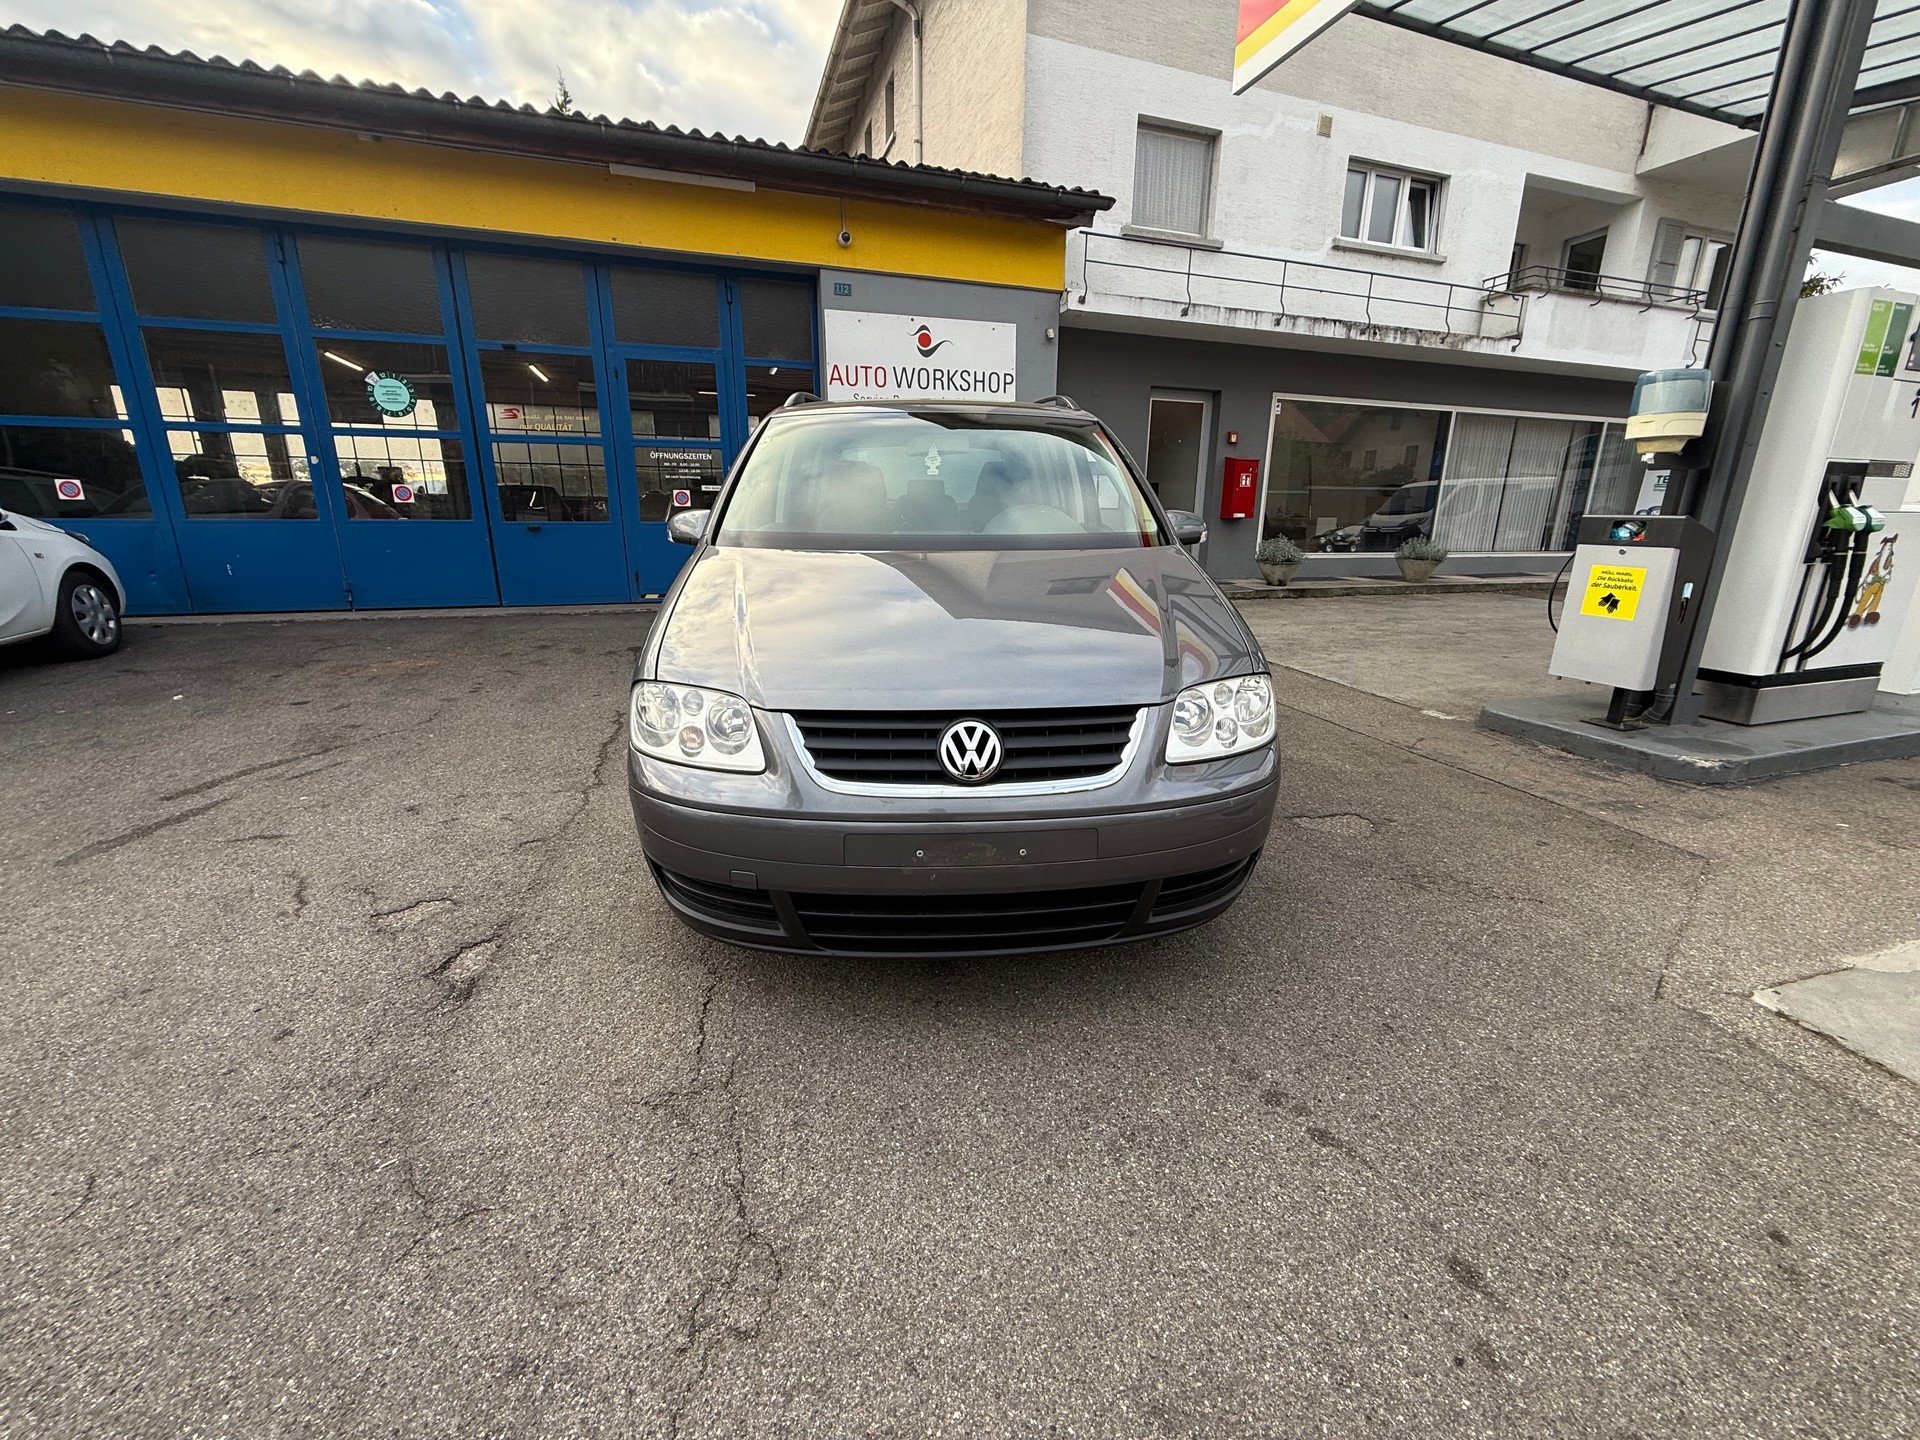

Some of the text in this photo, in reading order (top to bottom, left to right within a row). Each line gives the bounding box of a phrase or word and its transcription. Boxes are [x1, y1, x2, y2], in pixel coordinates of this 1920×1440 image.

[836, 284, 849, 294] 112
[829, 364, 1014, 394] AUTO WORKSHOP
[534, 422, 573, 431] QUALITÄT
[650, 451, 712, 460] ÖFFNUNGSZEITEN
[941, 721, 1001, 781] VW
